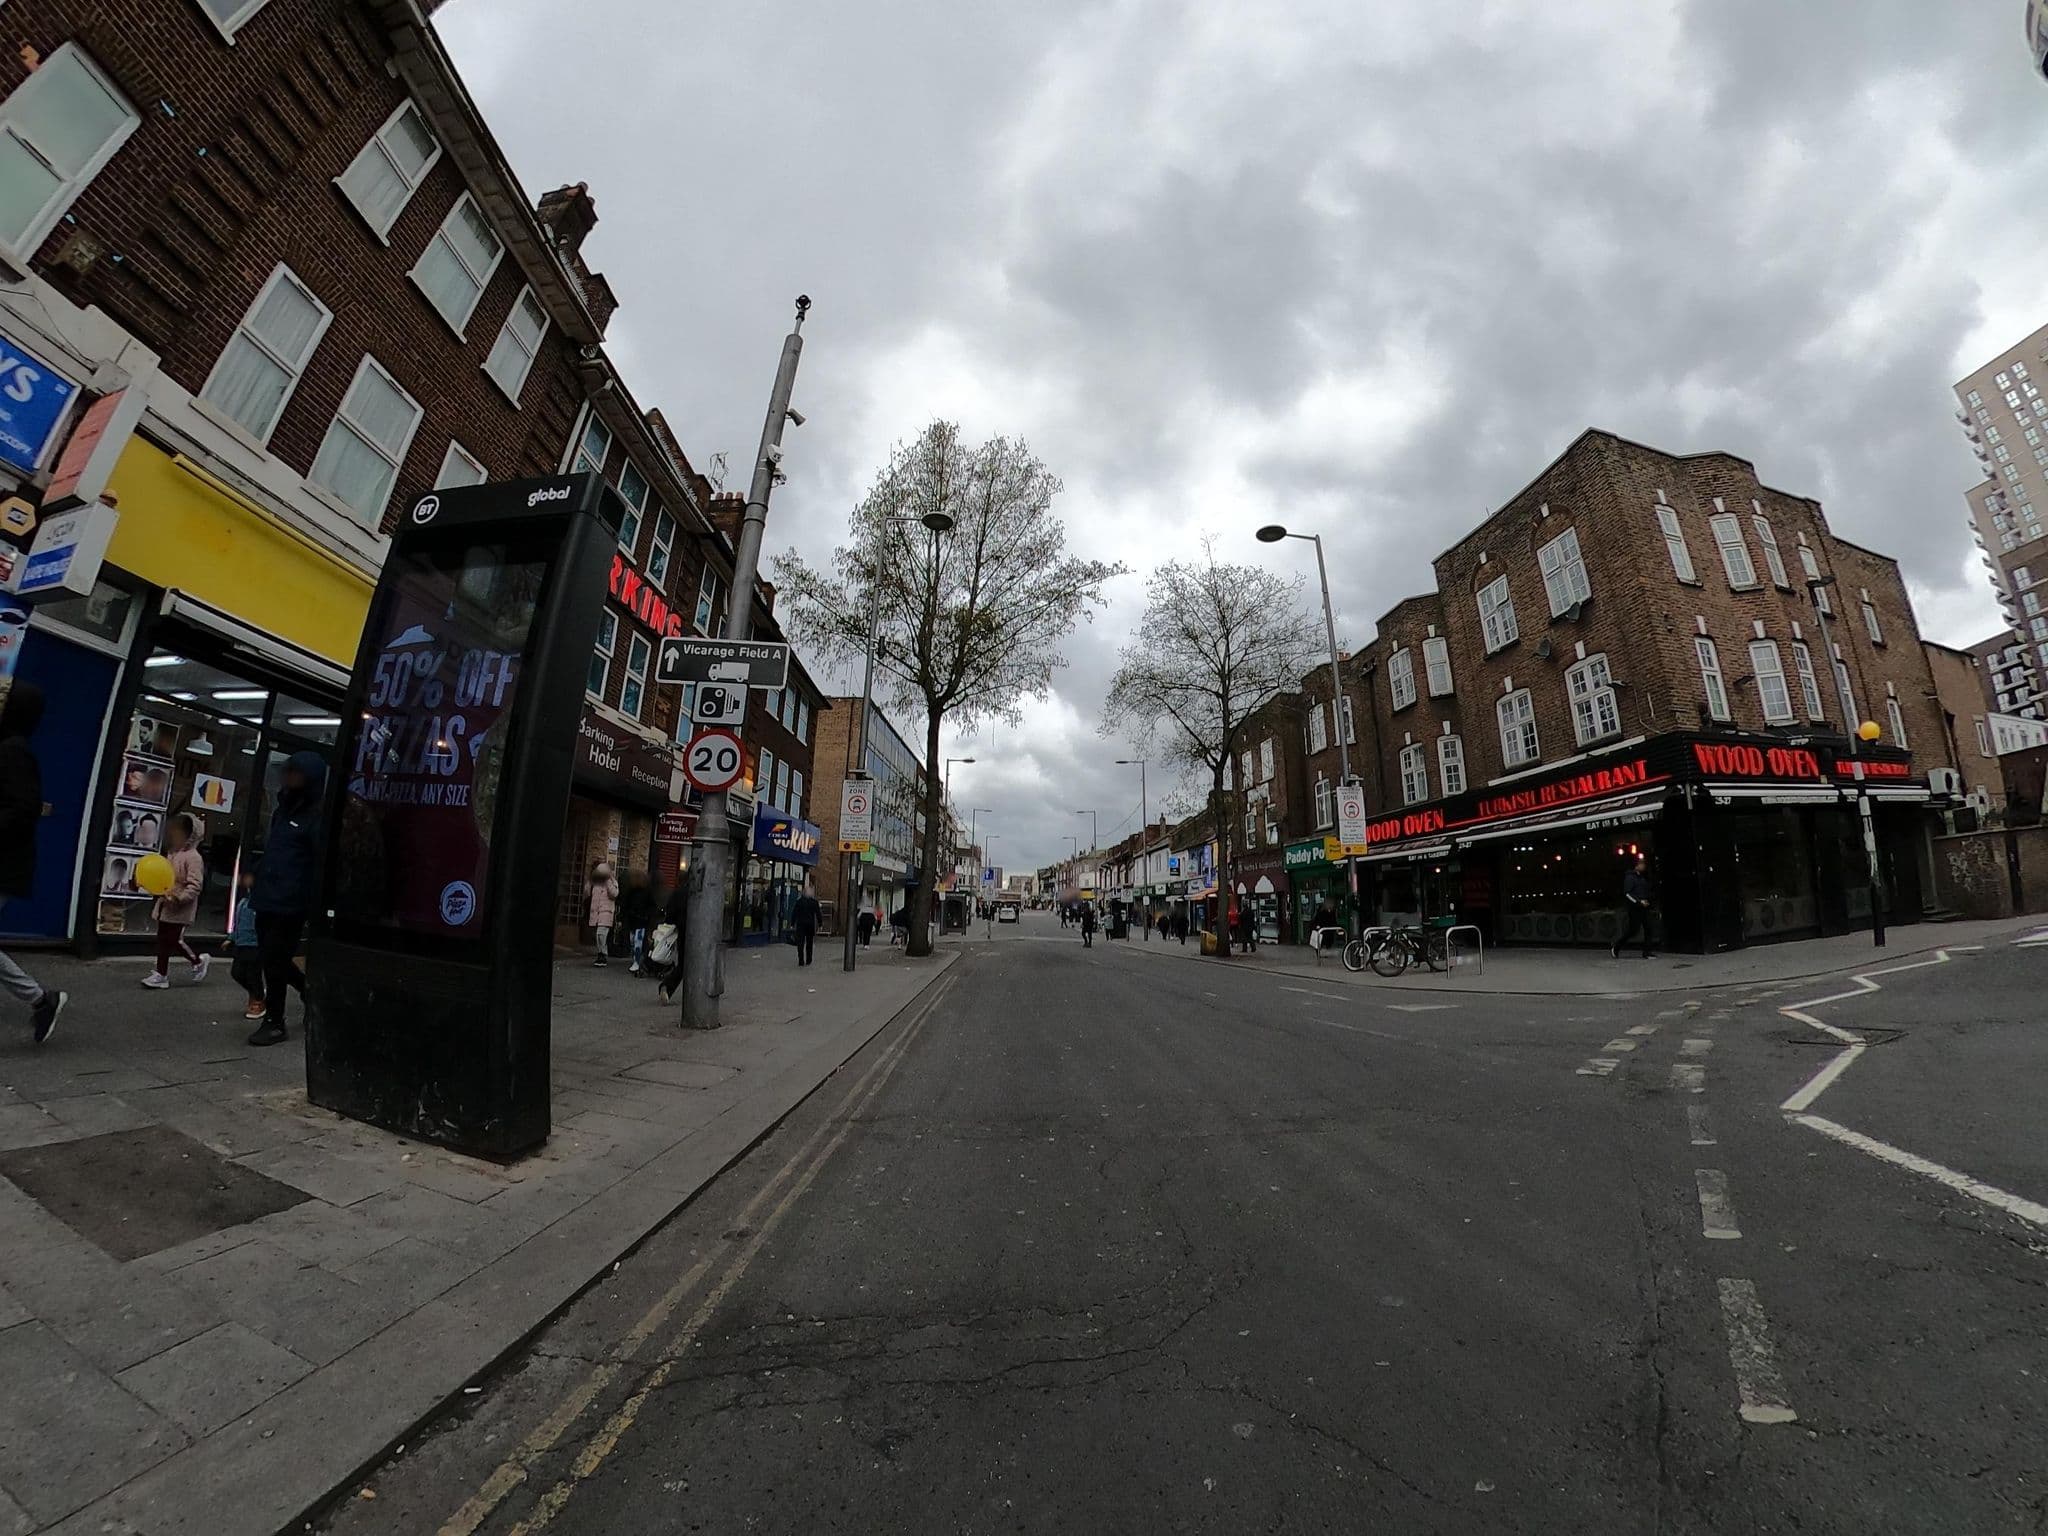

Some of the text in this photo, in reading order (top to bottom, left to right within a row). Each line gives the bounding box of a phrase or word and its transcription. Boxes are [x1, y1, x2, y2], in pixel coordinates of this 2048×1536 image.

[527, 485, 571, 507] global
[417, 503, 435, 516] BT
[683, 644, 782, 660] Vicarage Field A
[368, 648, 521, 709] 50% OFF
[354, 714, 467, 777] PIZZAS
[588, 743, 621, 773] Hotel
[693, 747, 737, 772] 20
[1694, 743, 1820, 778] WOOD OVEN
[631, 765, 669, 791] Reception
[1478, 789, 1536, 816] TURKISH
[1540, 759, 1648, 803] RESTAURANT
[420, 782, 443, 806] ANY
[445, 783, 470, 807] SIZE
[668, 824, 688, 833] Hotel
[1403, 807, 1444, 836] OVEN
[1586, 821, 1600, 830] EAT
[1286, 848, 1312, 865] Paddy
